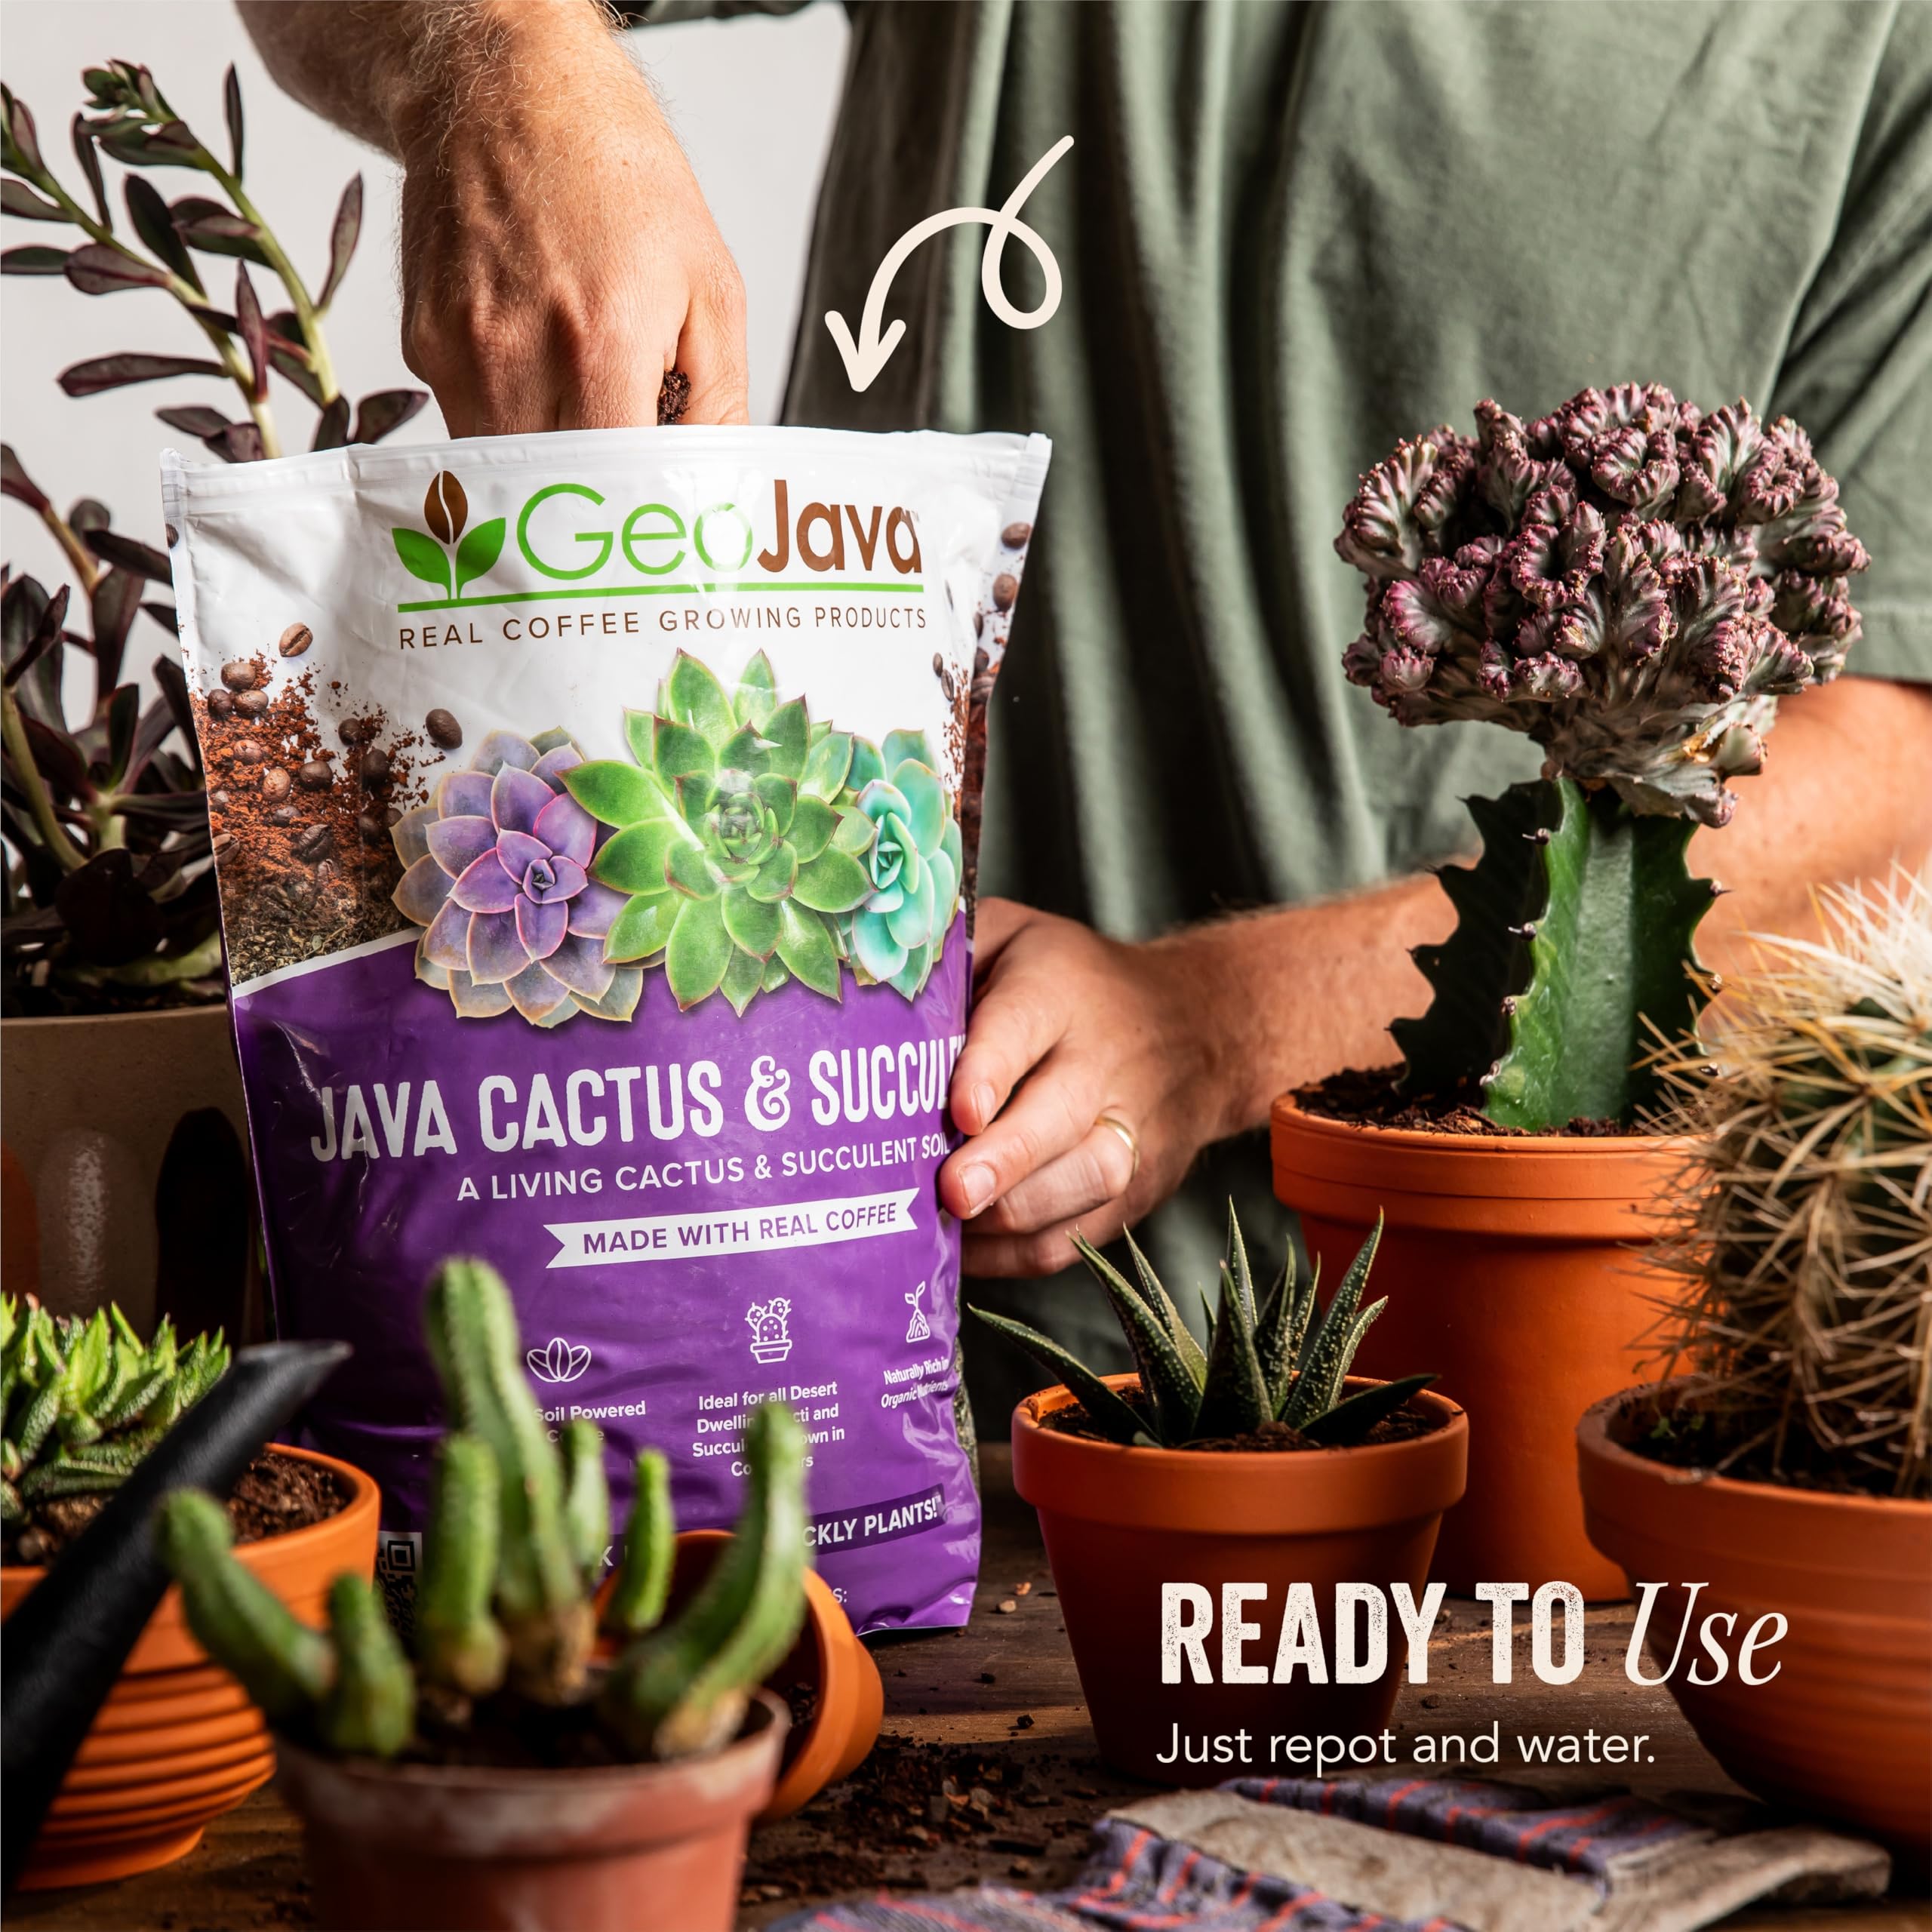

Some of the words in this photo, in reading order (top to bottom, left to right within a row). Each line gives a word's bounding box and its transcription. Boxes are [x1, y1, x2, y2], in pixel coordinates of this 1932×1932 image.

[399, 622, 483, 650] REAL
[503, 611, 639, 640] COFFEE
[659, 607, 801, 632] GROWING
[815, 607, 926, 629] PRODUCTS
[310, 1079, 457, 1162] JAVA
[478, 1059, 724, 1153] CACTUS
[744, 1055, 792, 1132] &
[457, 1177, 480, 1201] A
[491, 1168, 603, 1200] LIVING
[614, 1158, 745, 1191] CACTUS
[753, 1155, 773, 1180] &
[781, 1137, 917, 1177] SUCCULENT
[583, 1229, 668, 1256] MADE
[677, 1220, 749, 1247] WITH
[758, 1212, 818, 1240] REAL
[826, 1202, 897, 1232] COFFEE
[883, 1363, 924, 1385] Naturally
[923, 1358, 942, 1375] Rich
[940, 1355, 949, 1371] in
[534, 1406, 565, 1422] Soil
[570, 1400, 646, 1420] Powered
[699, 1393, 737, 1411] Ideal
[743, 1391, 764, 1405] for
[768, 1387, 786, 1401] all
[790, 1381, 838, 1400] Desert
[881, 1387, 918, 1409] Organic
[813, 1403, 839, 1421] and
[801, 1429, 829, 1445] own
[832, 1426, 845, 1441] in
[802, 1517, 857, 1547] CKLY
